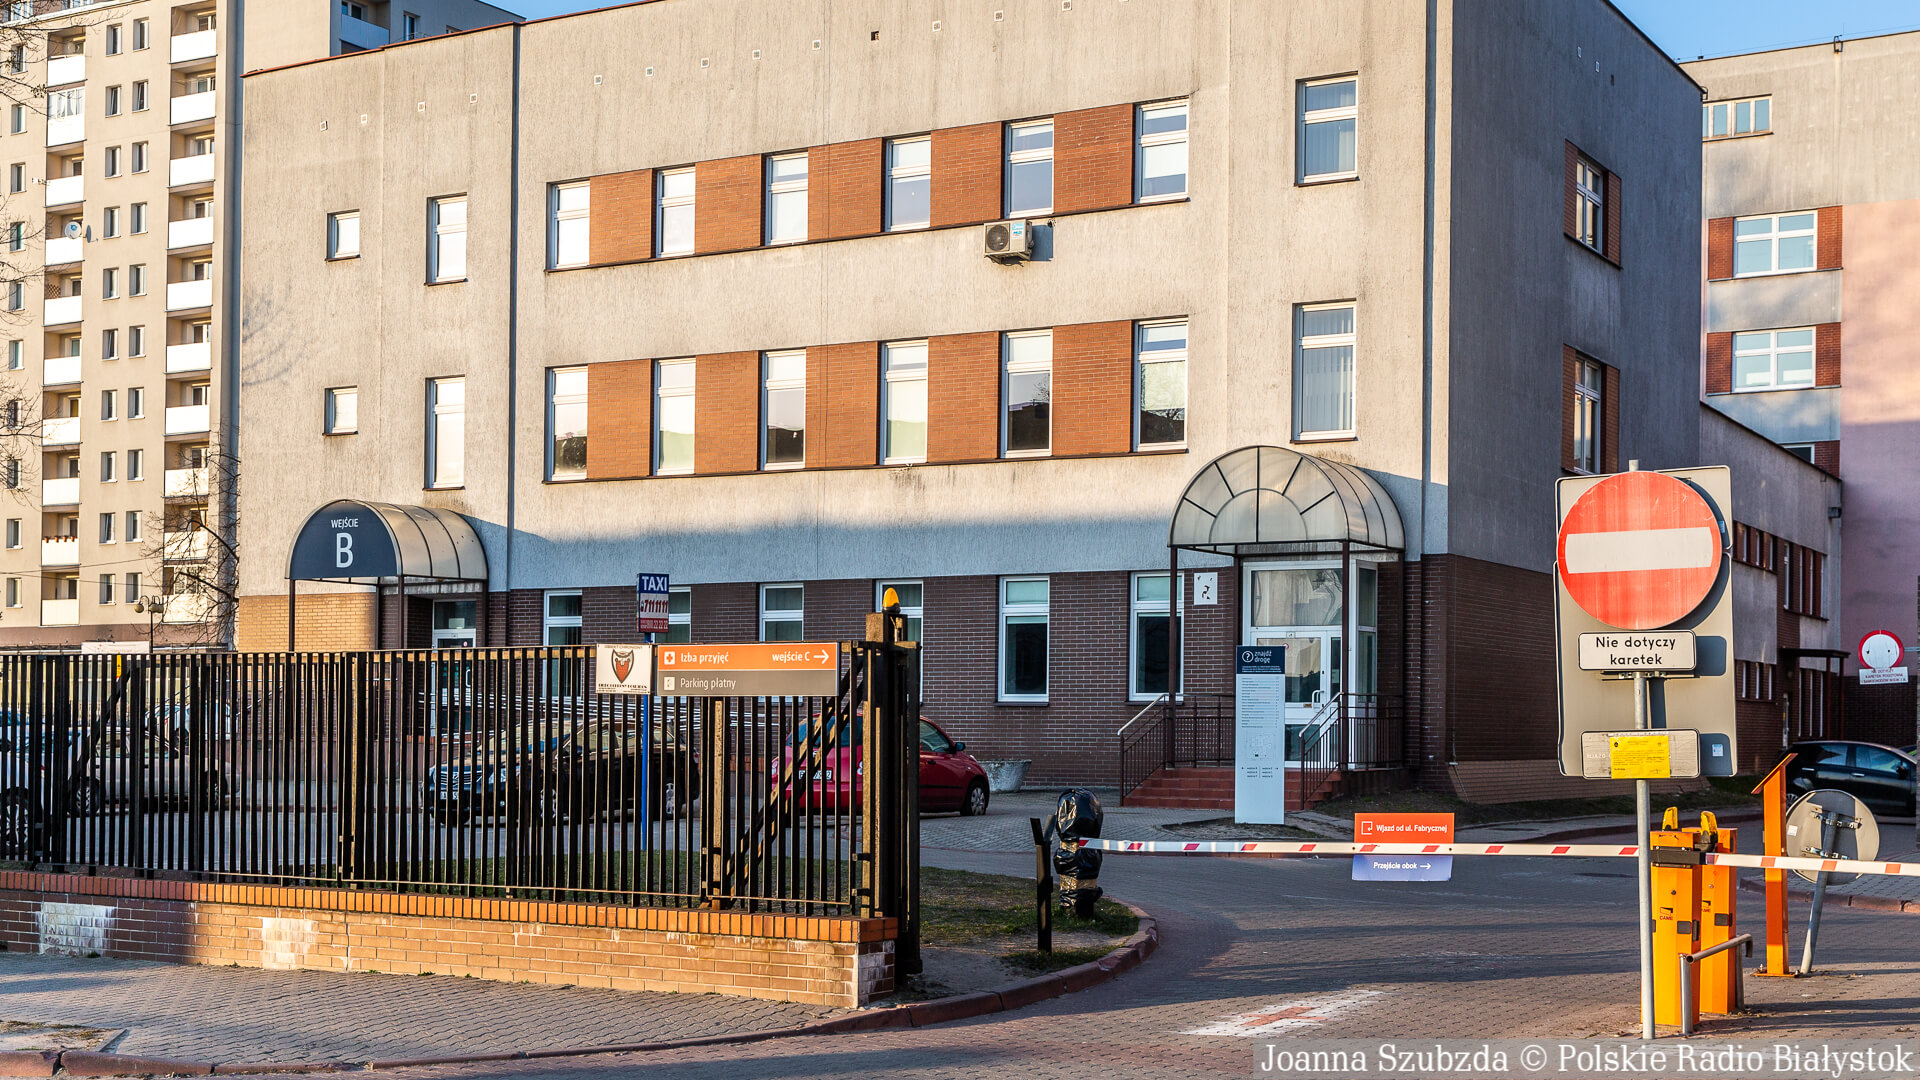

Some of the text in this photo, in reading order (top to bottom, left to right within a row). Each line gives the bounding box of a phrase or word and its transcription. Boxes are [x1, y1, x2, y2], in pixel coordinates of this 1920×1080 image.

[331, 517, 358, 529] WEJŚCIE
[336, 532, 353, 568] B
[641, 576, 667, 591] TAXI
[1596, 636, 1676, 650] Nie dotyczy
[681, 652, 728, 664] Izba przyjęć
[772, 651, 810, 664] wejście C
[1610, 654, 1662, 665] karetek
[680, 678, 736, 690] Parking płatny
[1376, 824, 1394, 832] Wjazd
[1396, 824, 1404, 832] od
[1414, 824, 1448, 833] Fabrycznej
[1373, 862, 1400, 870] Przejście
